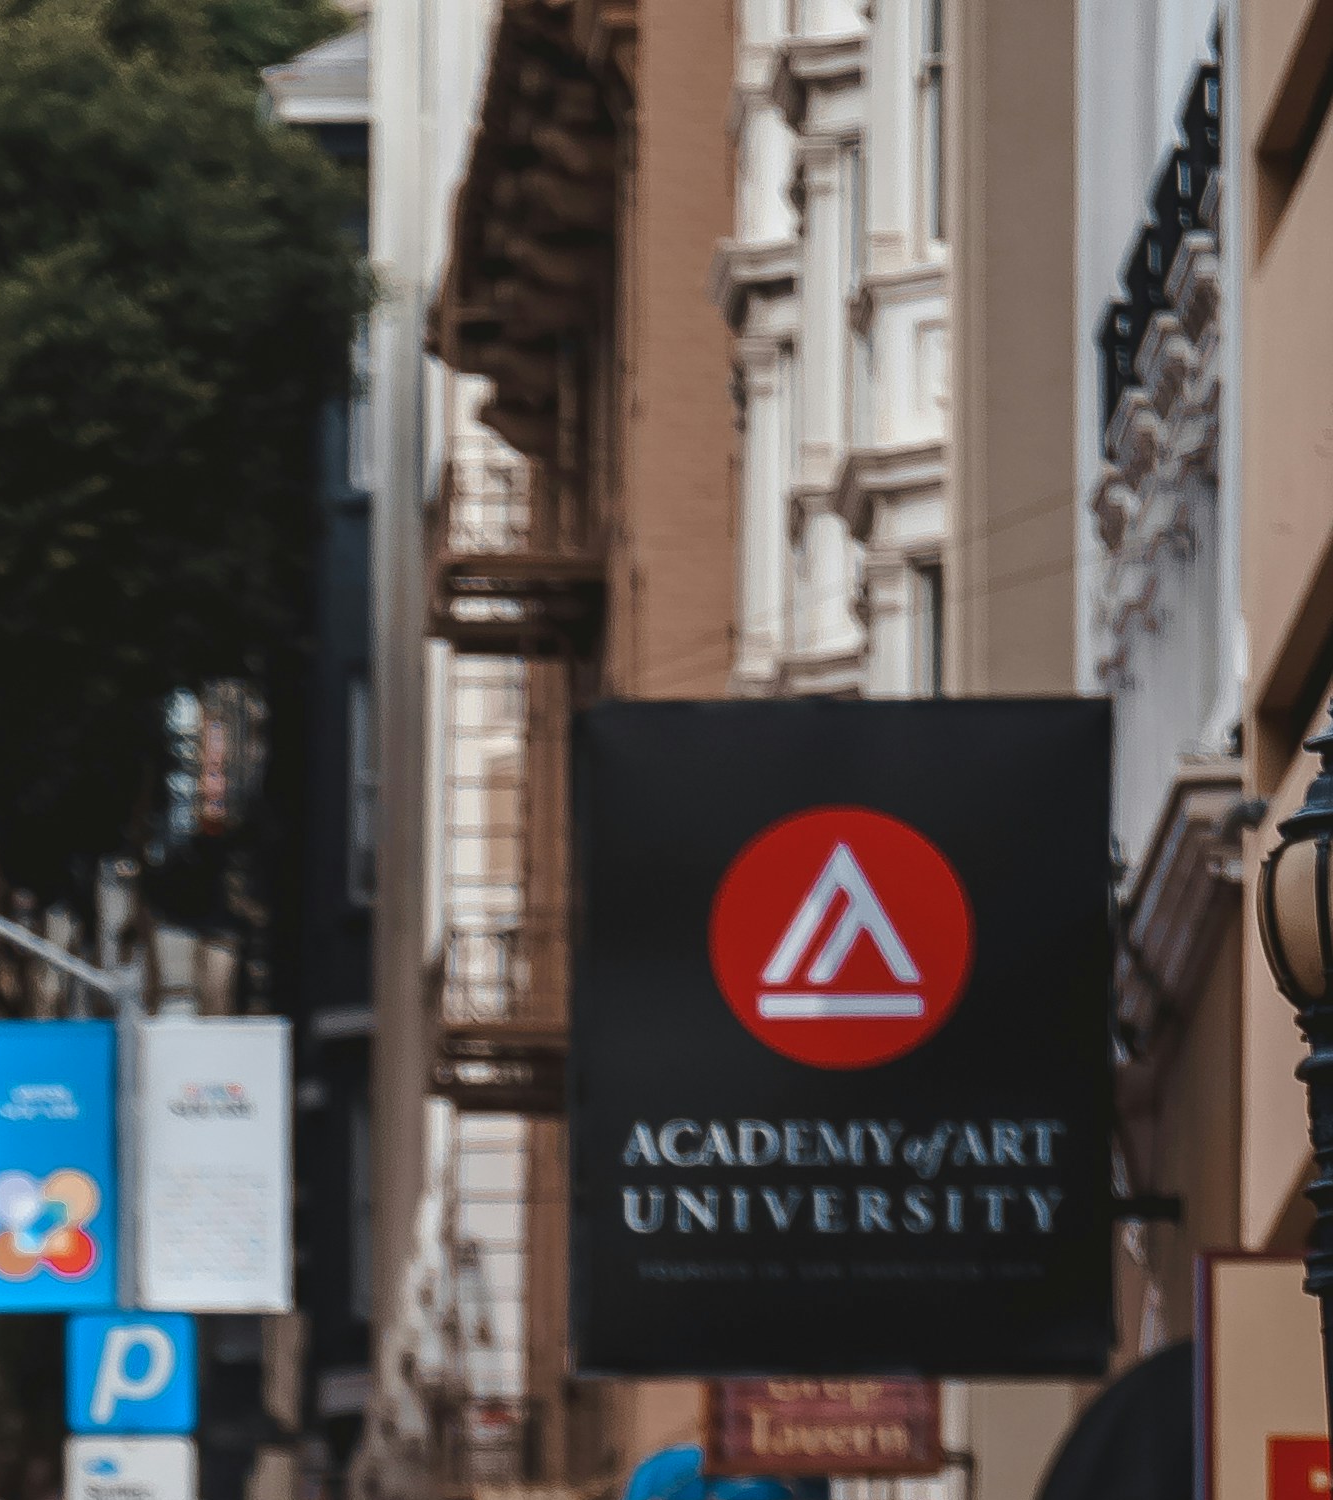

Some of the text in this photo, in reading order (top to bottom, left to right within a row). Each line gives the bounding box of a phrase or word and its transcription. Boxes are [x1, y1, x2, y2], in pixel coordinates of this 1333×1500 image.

[622, 1119, 1066, 1179] ACADEMY of ART
[623, 1186, 1062, 1233] UNIVERSITY
